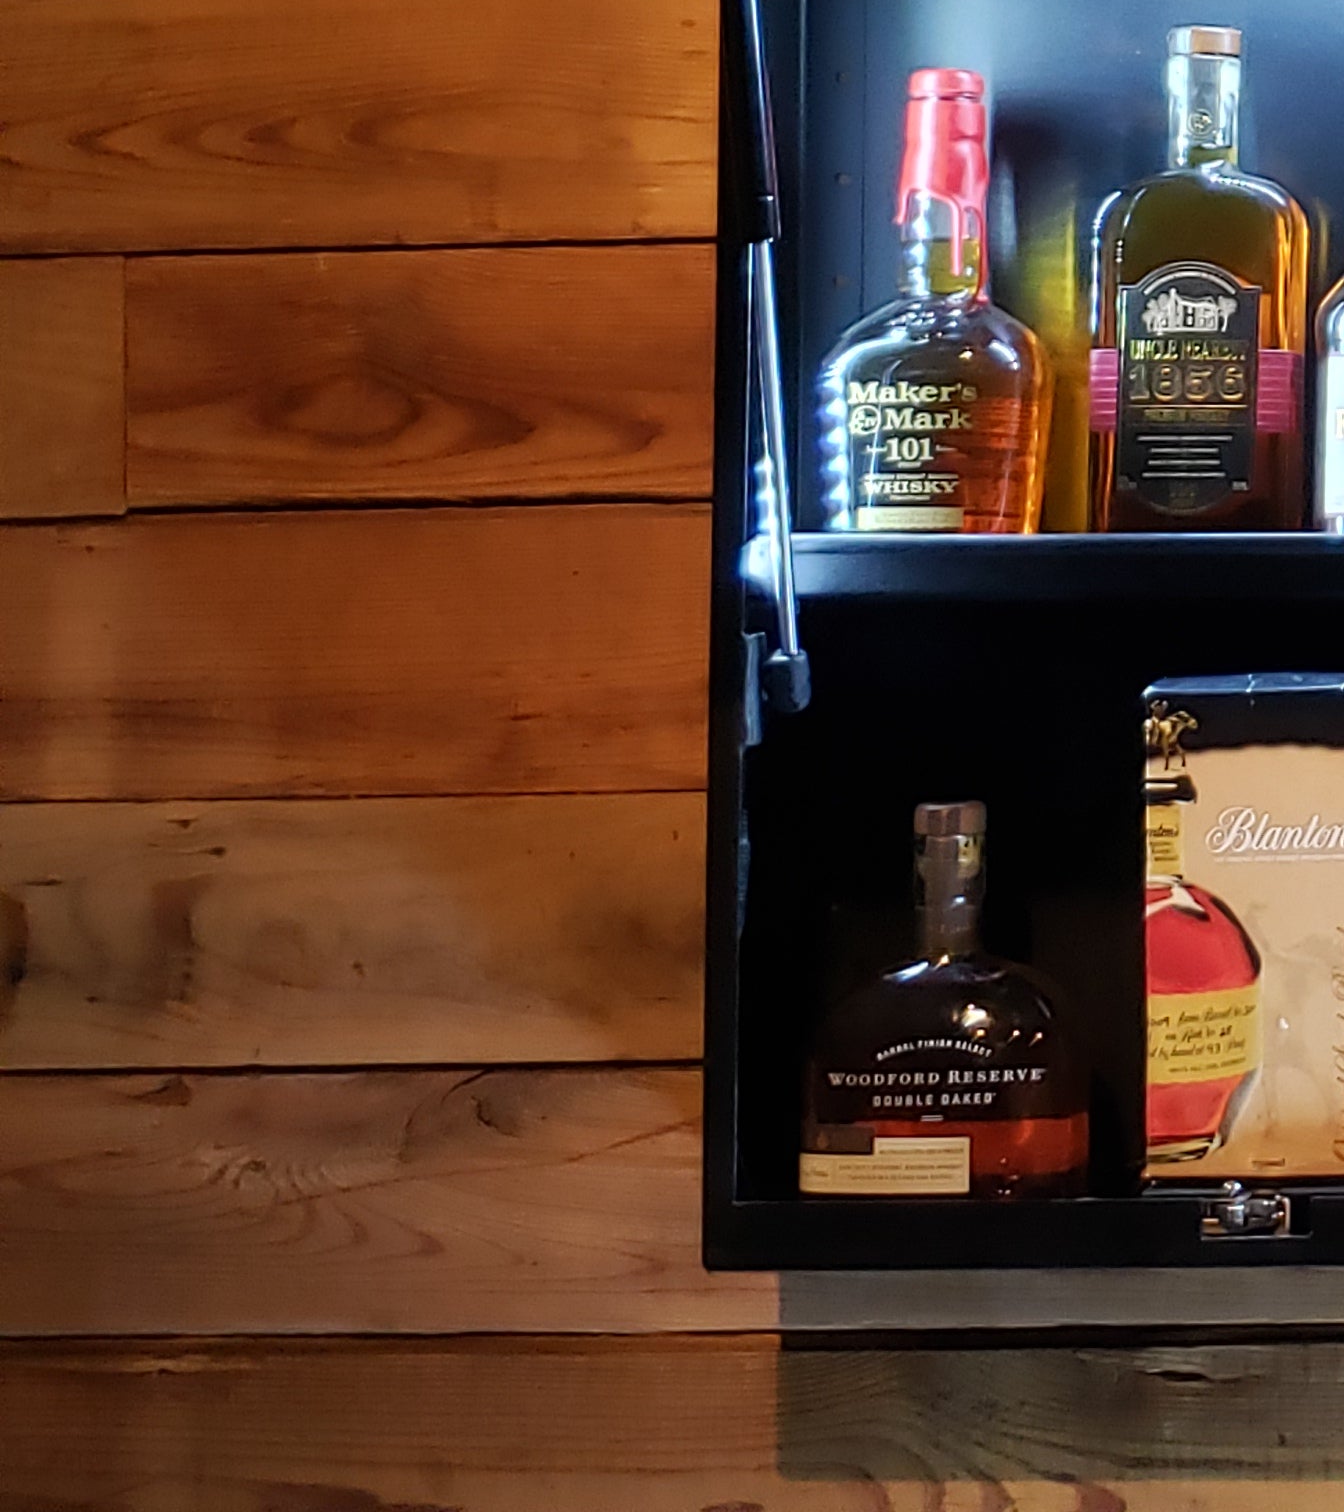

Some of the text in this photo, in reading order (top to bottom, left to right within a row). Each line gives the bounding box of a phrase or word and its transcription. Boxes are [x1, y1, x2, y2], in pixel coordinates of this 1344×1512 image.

[848, 381, 978, 404] Maker's
[1129, 363, 1246, 403] 1856
[882, 407, 973, 430] Mark
[885, 437, 934, 460] 101
[864, 480, 959, 494] WHISKY
[828, 1069, 1043, 1087] WOODFORD RESERVE
[873, 1093, 993, 1108] DOUBLE OAKED
